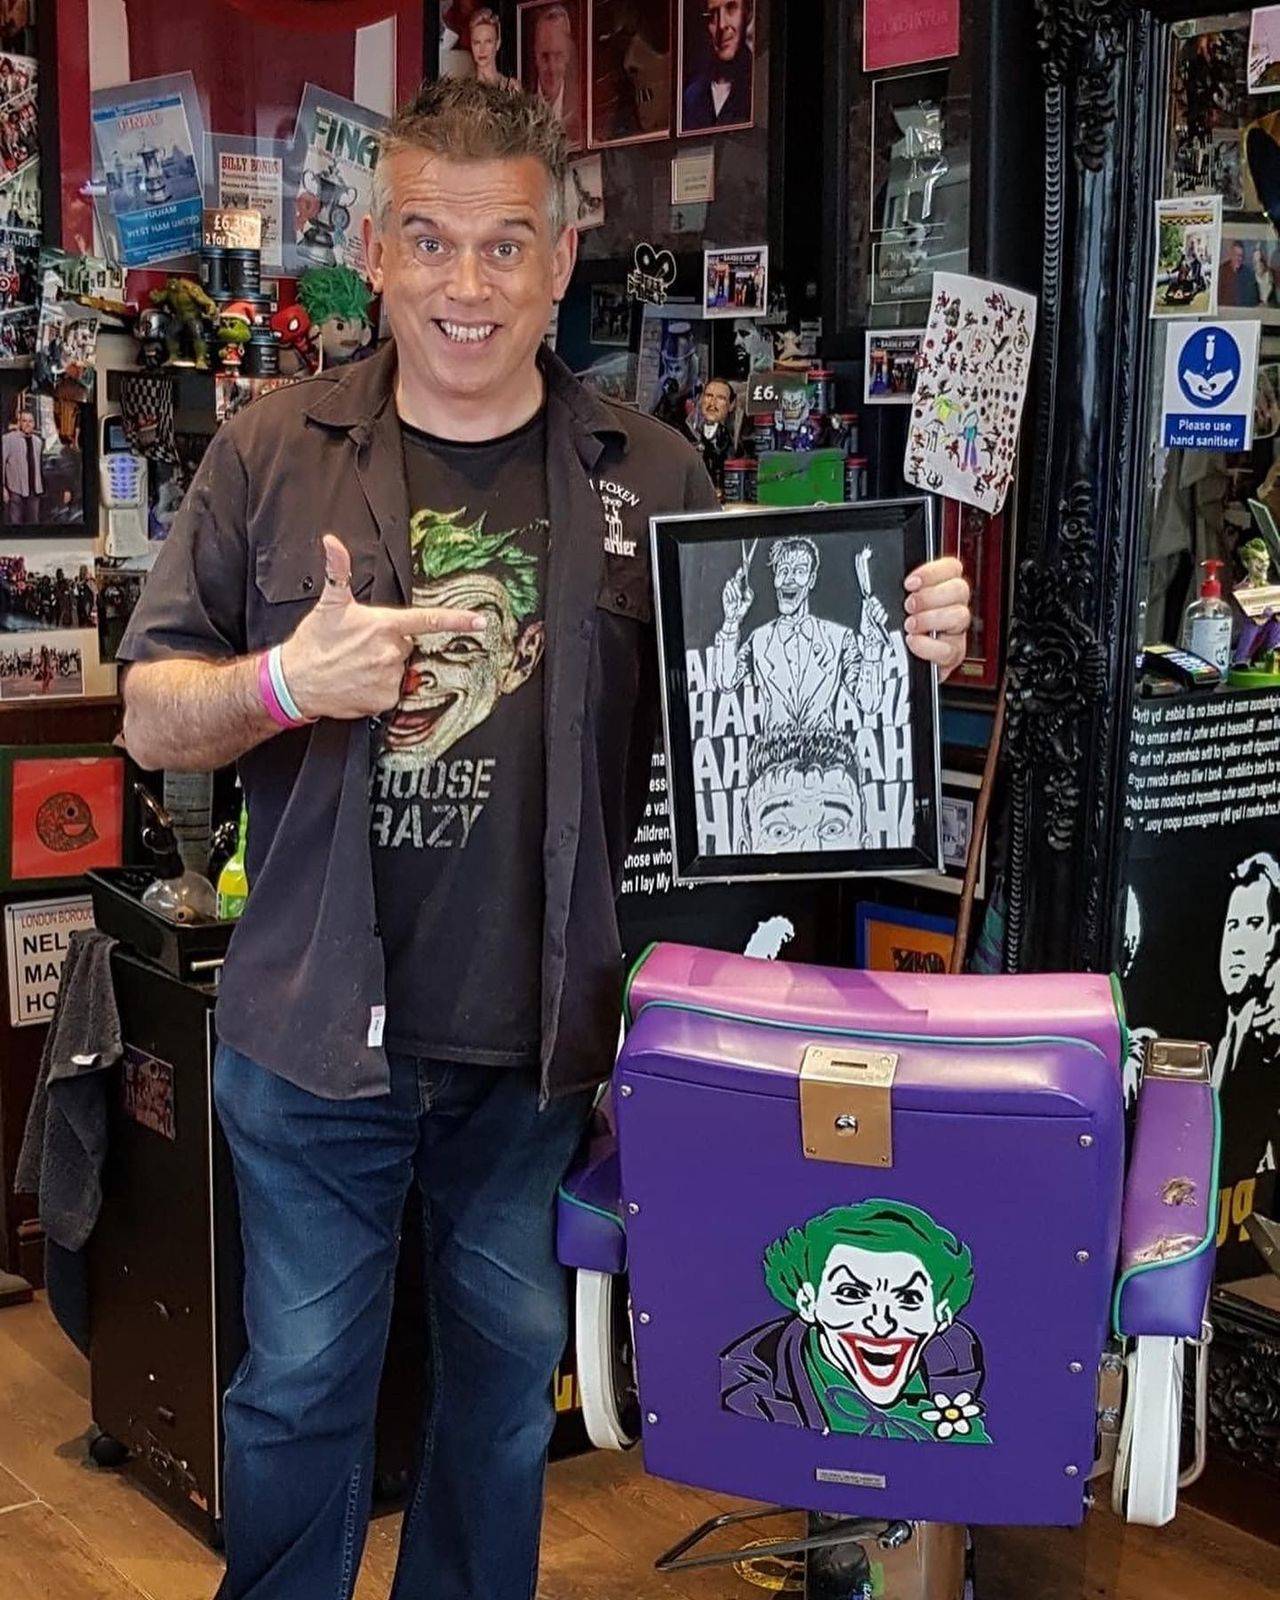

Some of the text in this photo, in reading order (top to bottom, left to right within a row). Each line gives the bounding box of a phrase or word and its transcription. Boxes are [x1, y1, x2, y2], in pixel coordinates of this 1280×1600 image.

[1178, 419, 1232, 431] Please use
[1170, 434, 1240, 447] hand sanitiser
[600, 479, 640, 507] FOXEN
[652, 848, 673, 866] who
[635, 875, 640, 892] I
[640, 874, 655, 895] lay
[656, 872, 671, 893] My
[21, 911, 57, 929] LONDON
